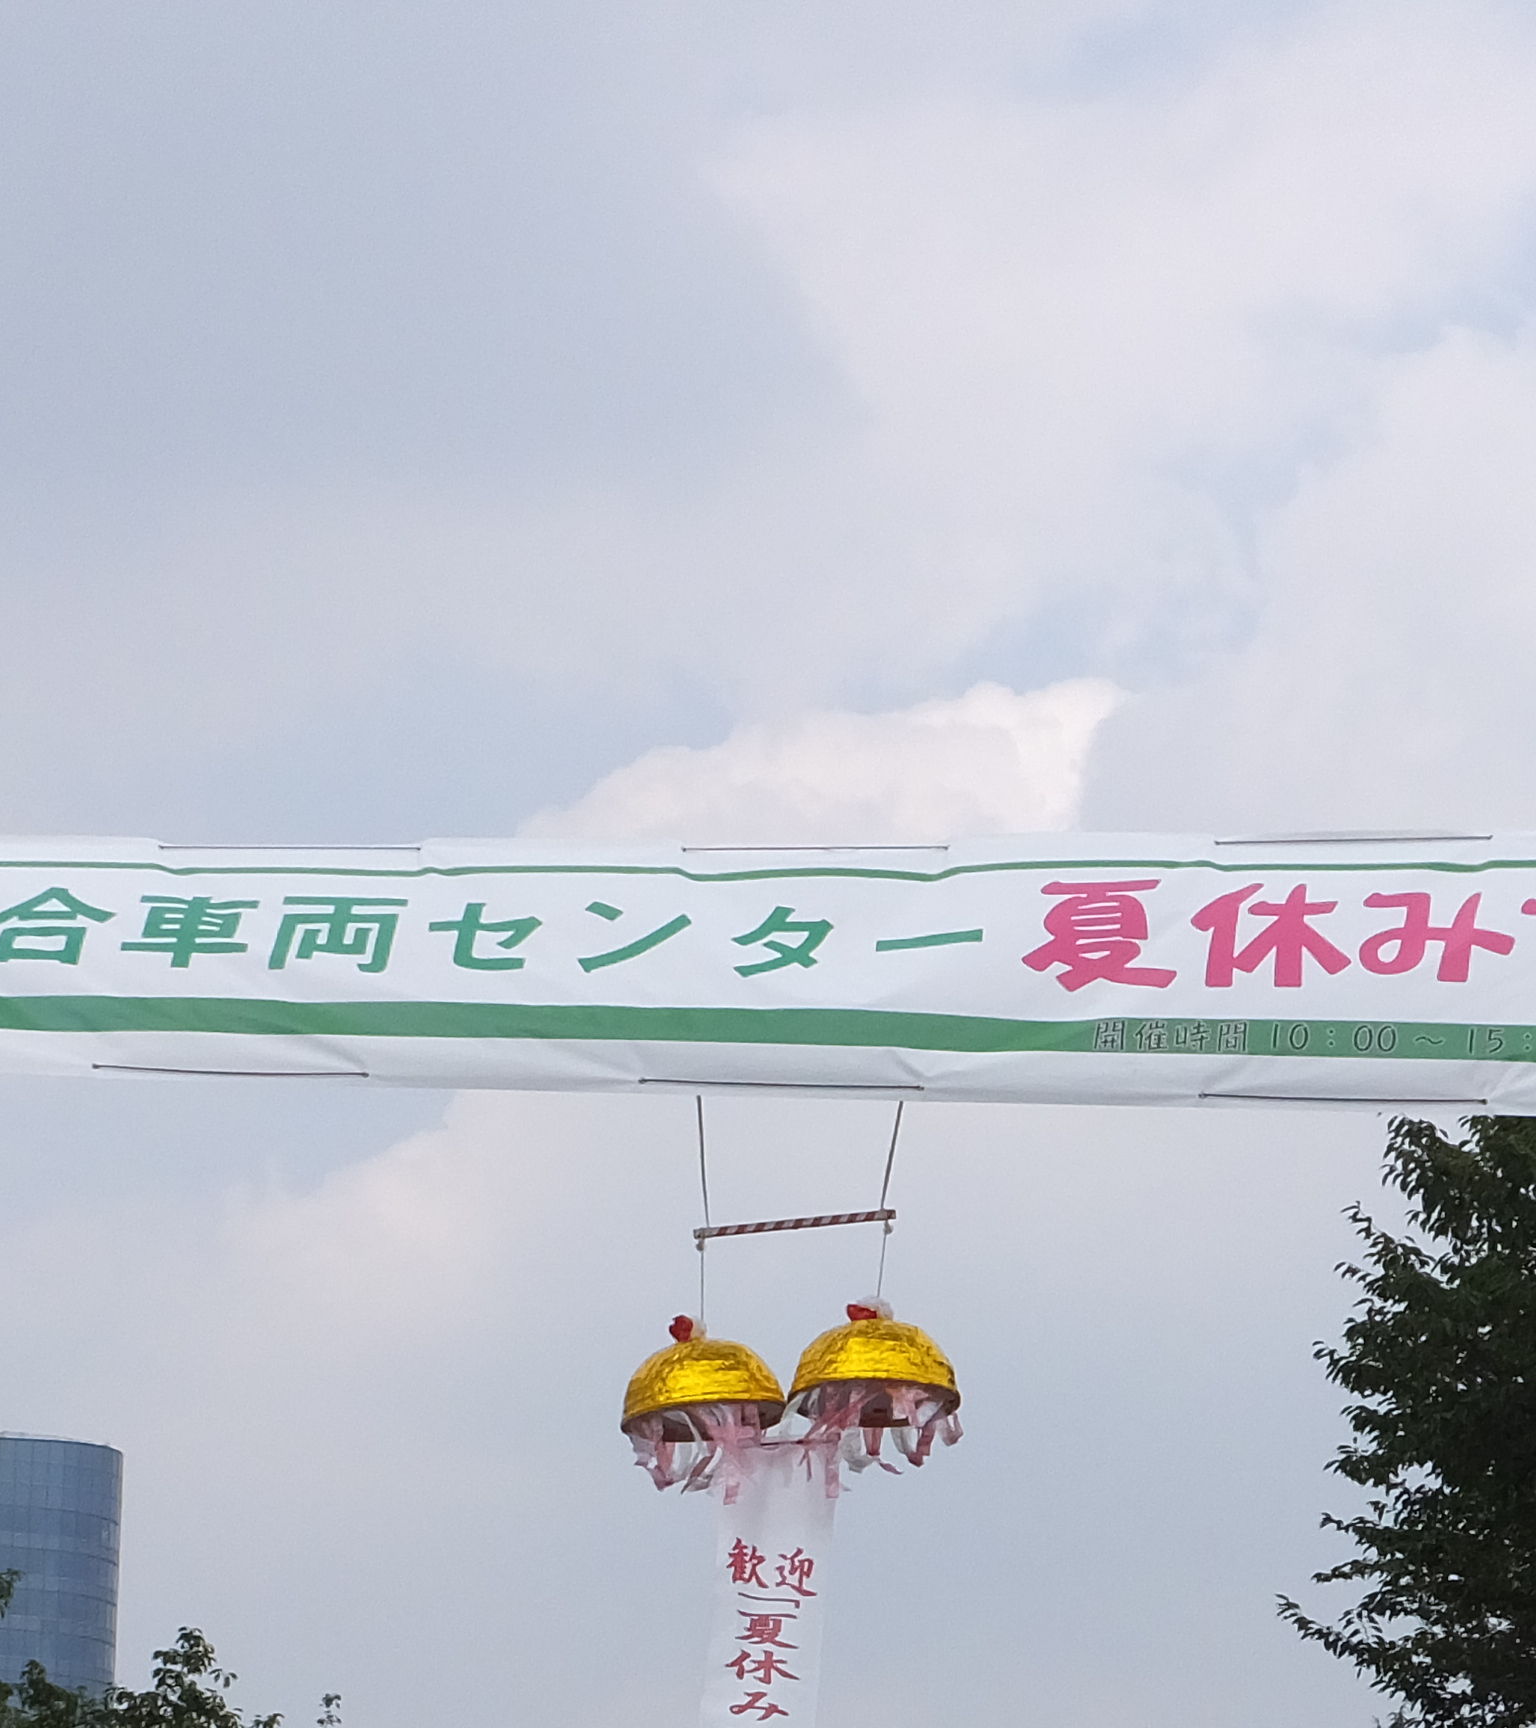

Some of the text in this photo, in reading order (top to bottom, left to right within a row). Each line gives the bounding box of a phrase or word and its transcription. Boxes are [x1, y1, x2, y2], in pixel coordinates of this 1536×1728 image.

[1094, 1020, 1248, 1051] 開催時間
[724, 1537, 817, 1598] 歓迎
